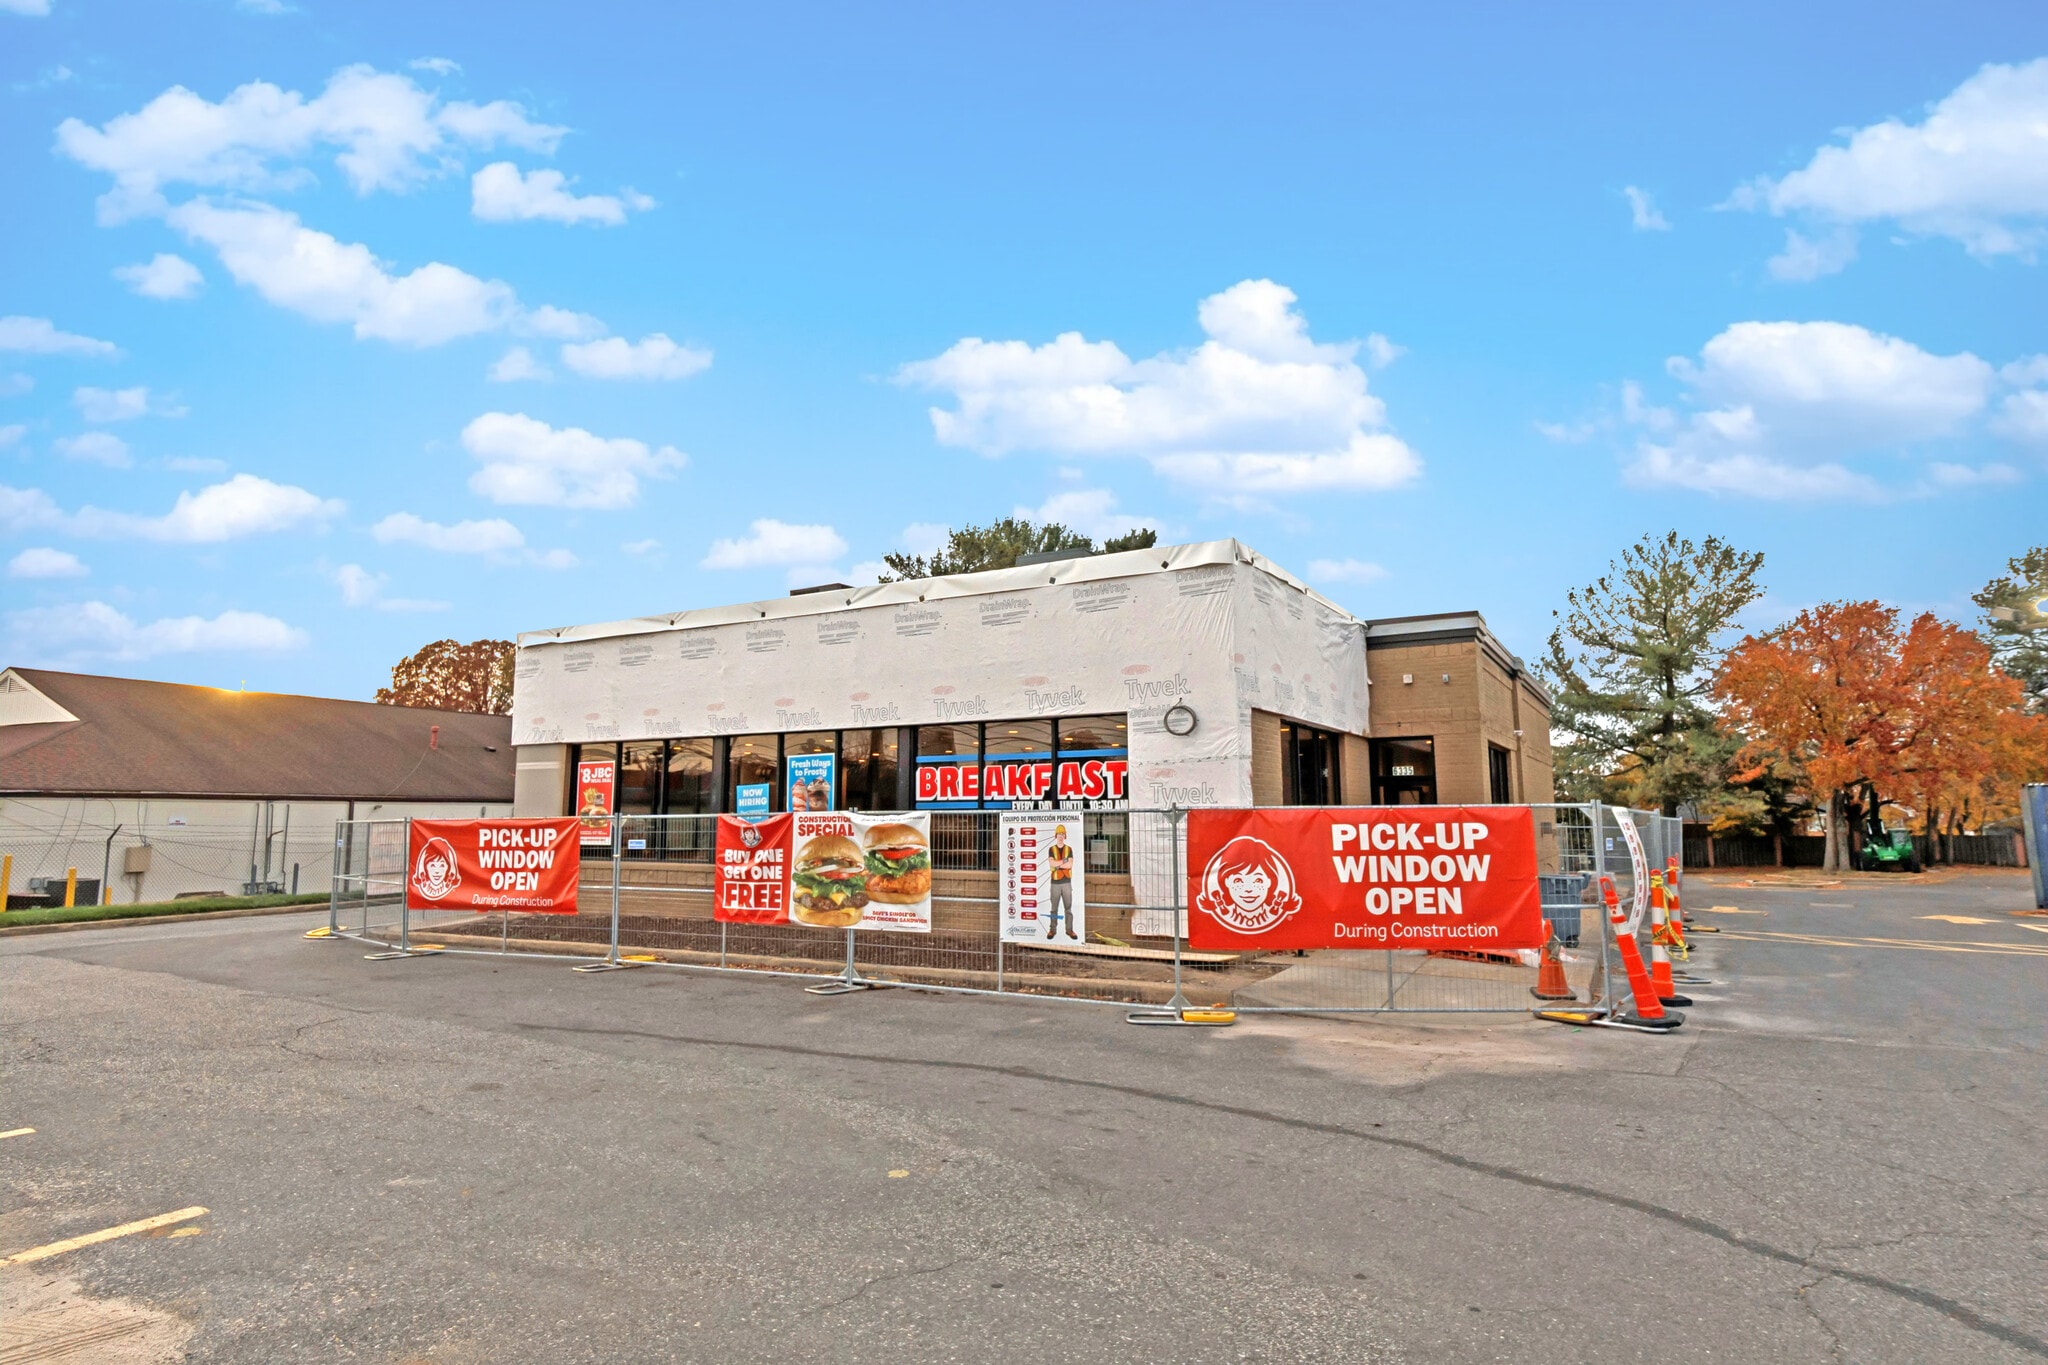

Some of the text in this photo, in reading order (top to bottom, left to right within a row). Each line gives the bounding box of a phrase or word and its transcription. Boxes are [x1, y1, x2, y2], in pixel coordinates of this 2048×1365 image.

[1072, 582, 1130, 599] DrainWrap
[979, 598, 1032, 613] DrainWrap
[895, 610, 942, 624] DrainWrap
[1124, 674, 1191, 704] Tyvek
[934, 695, 988, 720] Tyvek
[1025, 685, 1085, 714] Tyvek
[708, 712, 749, 733] Tyvek
[776, 708, 822, 729] Tyvek
[851, 702, 900, 726] Tyvek
[591, 767, 612, 778] JBC
[791, 759, 831, 769] Fresh Ways
[795, 768, 827, 777] to Frosty
[916, 761, 1128, 800] BREAKFAST
[739, 797, 767, 806] HIRING
[743, 788, 763, 796] NOW
[1150, 782, 1218, 809] Tyvek
[1012, 800, 1034, 811] EVERY
[1089, 800, 1113, 810] 10:30
[479, 828, 557, 847] PICK-UP
[798, 824, 854, 837] SPECIAL
[1331, 823, 1489, 851] PICK-UP
[478, 850, 555, 869] WINDOW
[724, 848, 784, 863] BUY ONE
[723, 865, 783, 880] GET ONE
[1332, 854, 1490, 883] WINDOW
[490, 872, 539, 891] OPEN
[472, 893, 553, 907] During Construction
[725, 882, 781, 909] FREE
[1365, 887, 1462, 915] OPEN
[1334, 922, 1498, 941] During Construction
